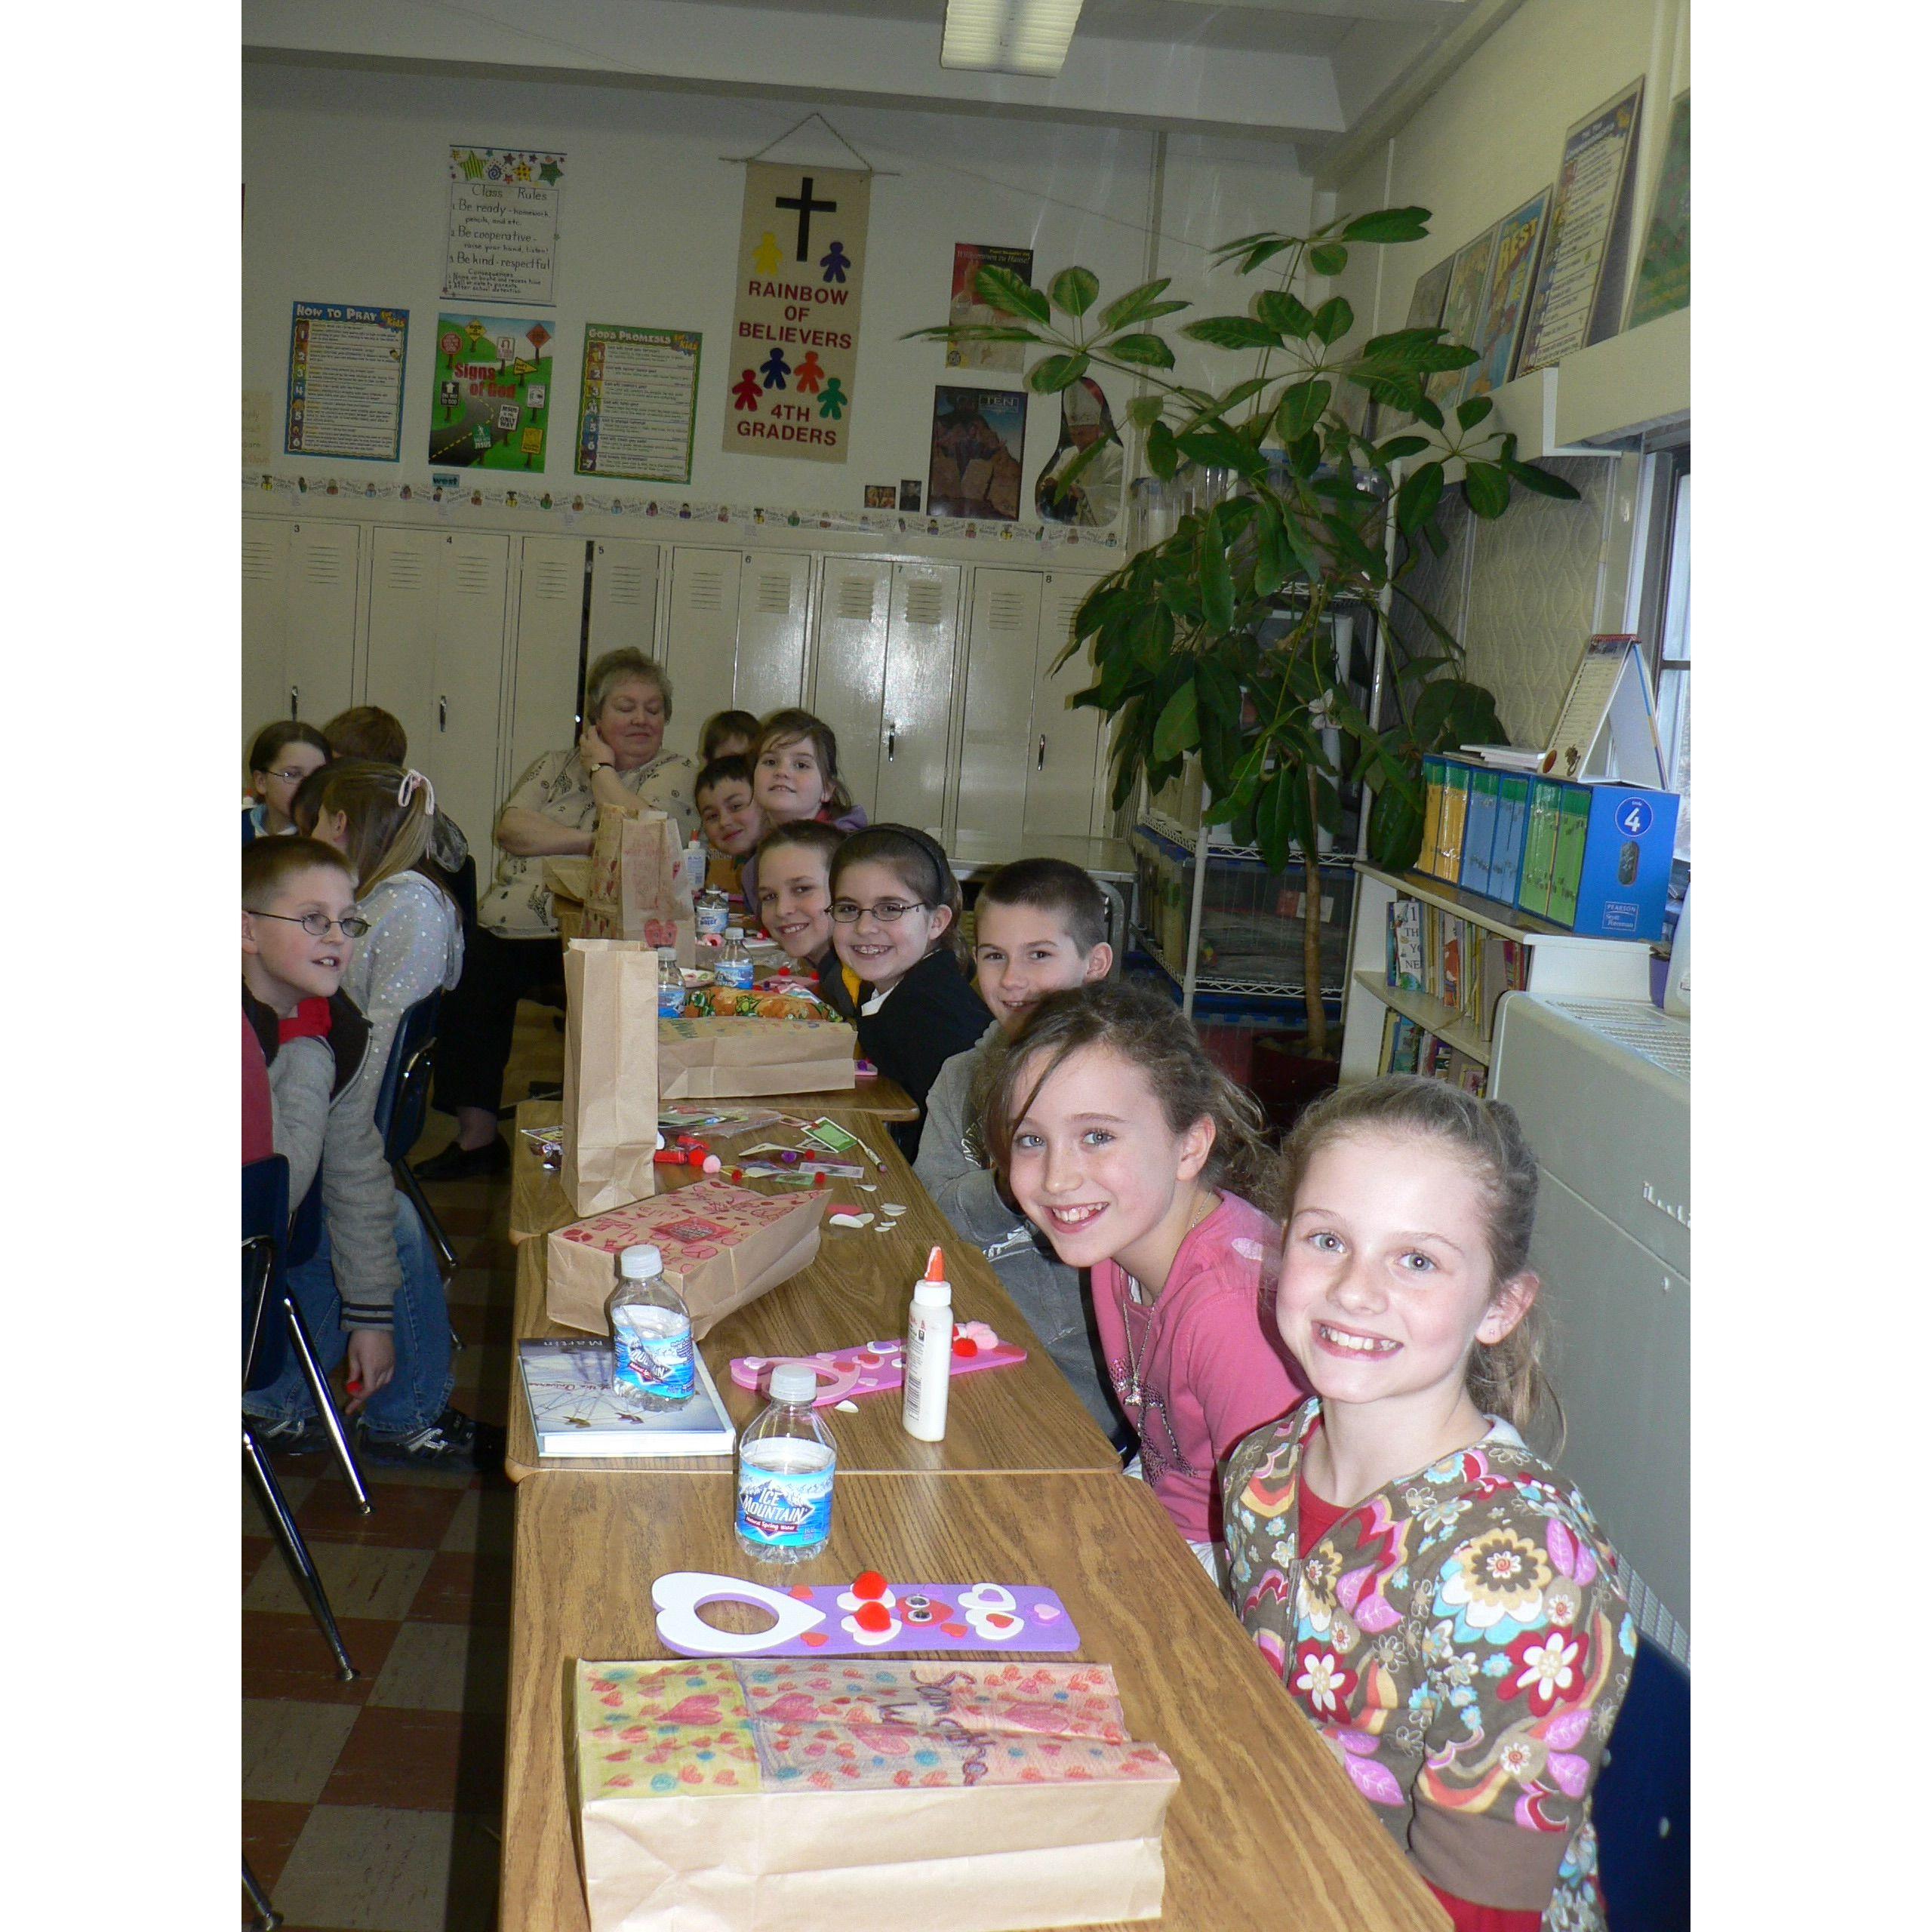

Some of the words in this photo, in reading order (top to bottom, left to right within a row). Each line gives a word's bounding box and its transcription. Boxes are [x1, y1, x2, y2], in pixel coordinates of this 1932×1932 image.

[472, 184, 503, 198] Class
[517, 187, 548, 200] Rules
[458, 198, 472, 212] Be
[477, 201, 507, 217] ready
[458, 224, 472, 238] Be
[457, 251, 470, 264] Be
[472, 253, 494, 266] kind
[500, 257, 550, 272] respectful
[748, 280, 849, 306] RAINBOW
[784, 306, 810, 323] OF
[739, 321, 852, 350] BELIEVERS
[454, 362, 496, 380] Signs
[469, 382, 485, 396] of
[488, 382, 516, 398] God
[984, 396, 1014, 407] TEN
[771, 403, 811, 423] 4TH
[737, 420, 837, 447] GRADERS
[294, 525, 300, 533] 3
[446, 536, 453, 545] 4
[598, 546, 605, 555] 5
[745, 555, 752, 564] 6
[1045, 575, 1053, 584] 8
[1623, 807, 1641, 833] 4
[1607, 904, 1636, 912] PEARSON
[758, 1487, 781, 1506] ICE
[743, 1494, 805, 1524] MOUNTAIN
[746, 1515, 761, 1526] Natural
[761, 1520, 779, 1531] Spring
